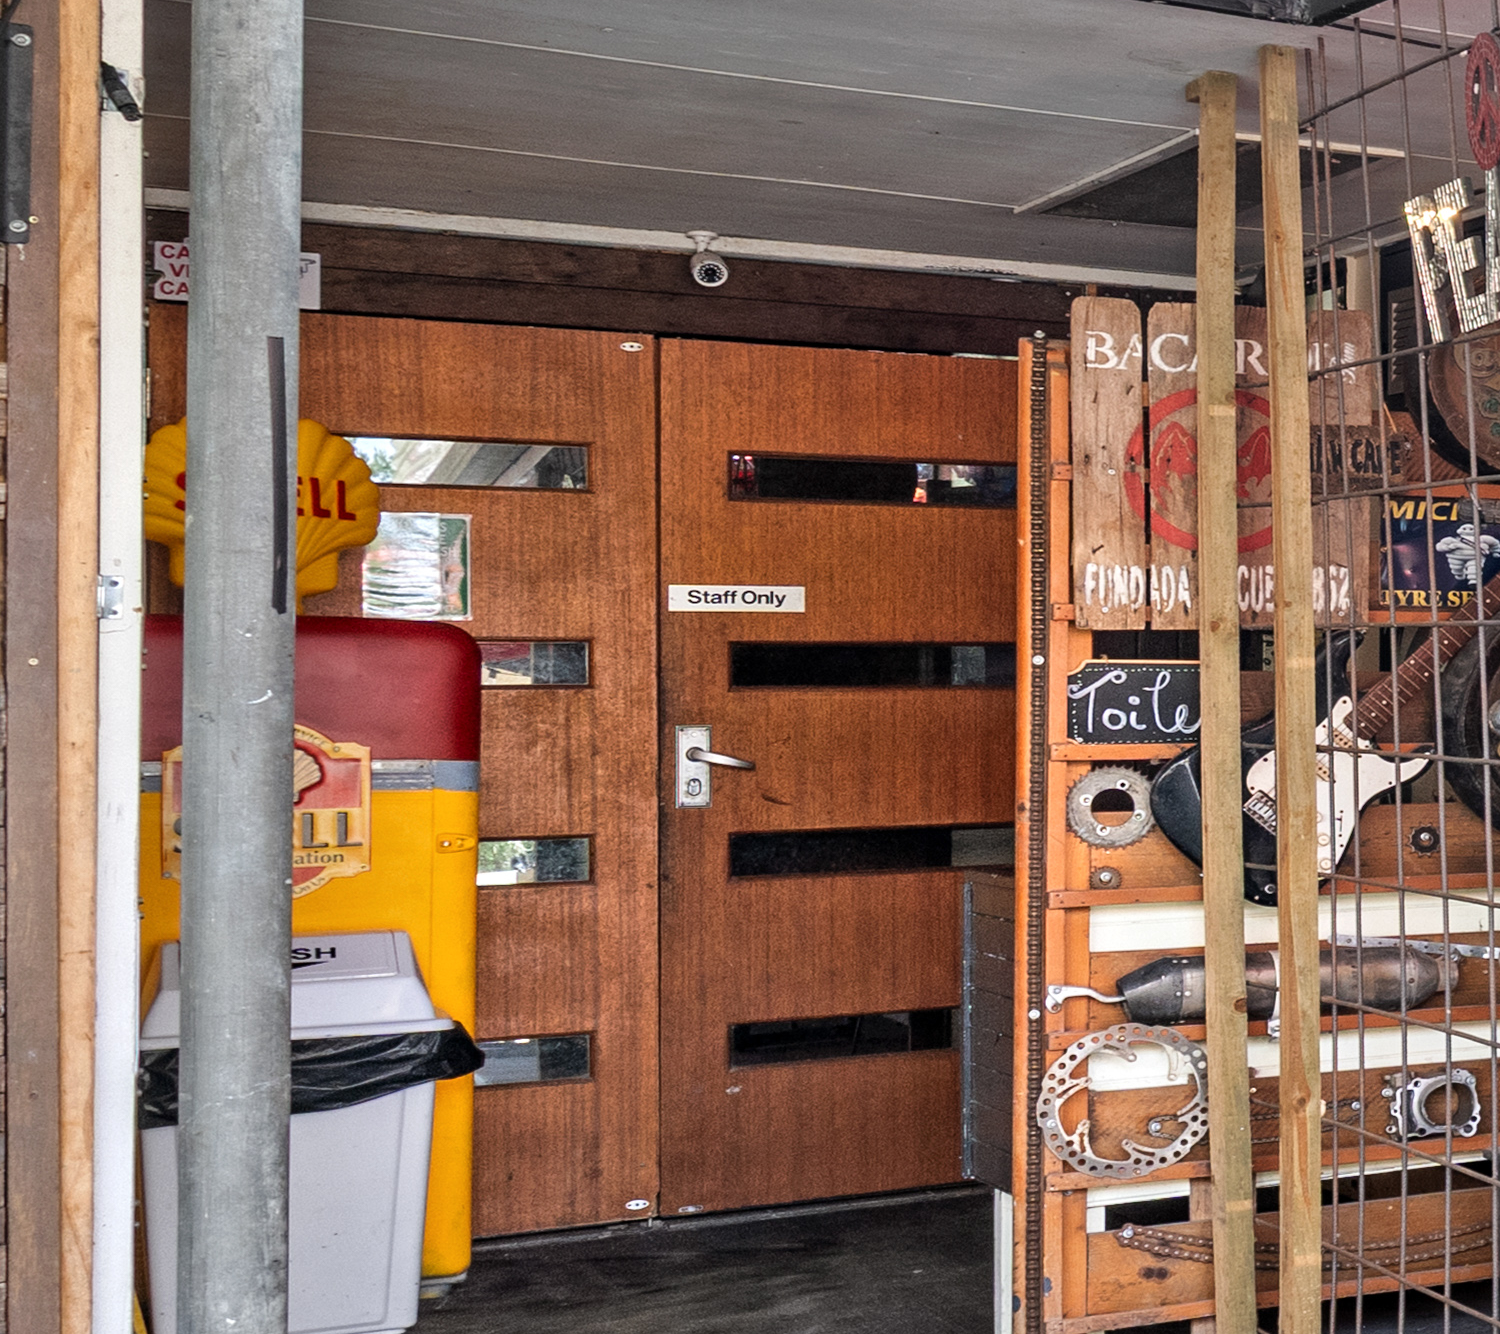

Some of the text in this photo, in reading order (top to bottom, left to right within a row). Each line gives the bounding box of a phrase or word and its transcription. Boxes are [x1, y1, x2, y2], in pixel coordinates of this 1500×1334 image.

[1084, 562, 1193, 613] FUNDADA
[687, 589, 787, 608] Staff Only
[1381, 589, 1434, 607] TYRE
[1067, 670, 1202, 734] Toile
[293, 850, 345, 866] ation
